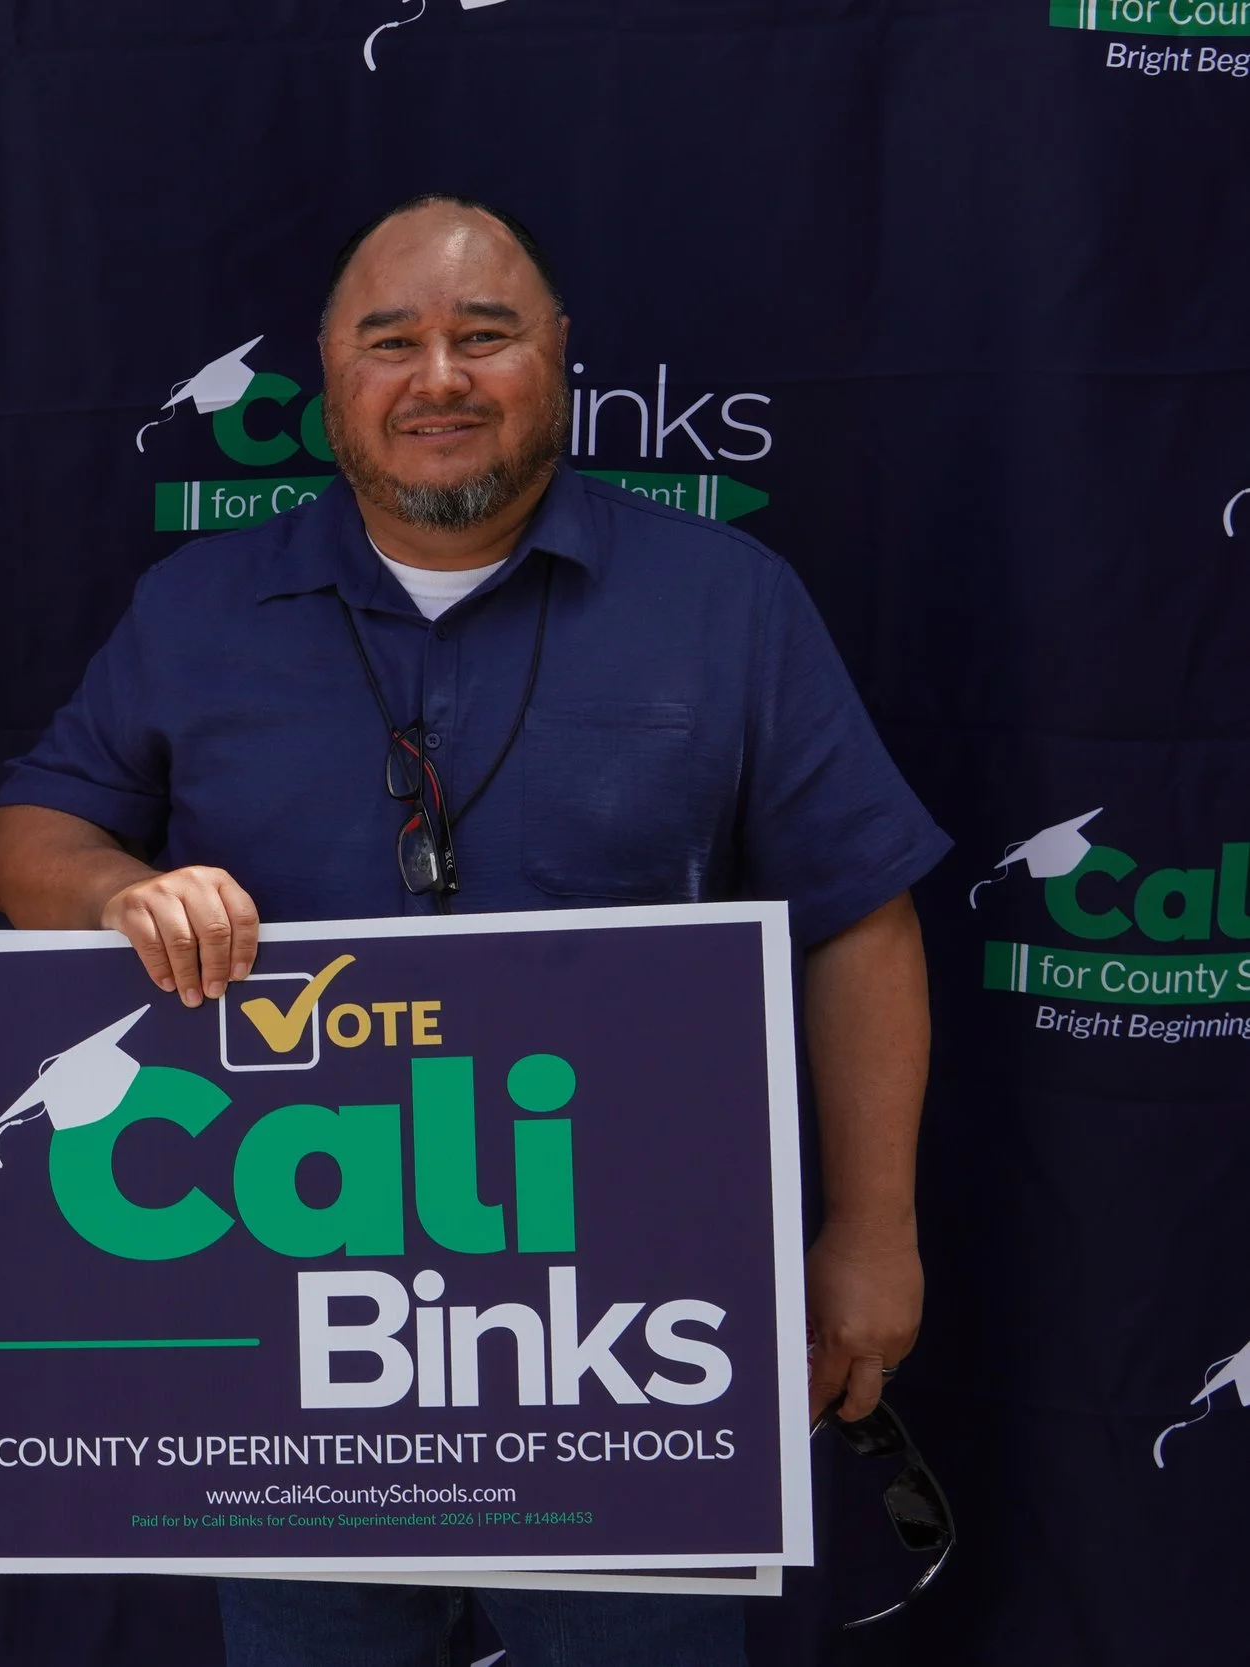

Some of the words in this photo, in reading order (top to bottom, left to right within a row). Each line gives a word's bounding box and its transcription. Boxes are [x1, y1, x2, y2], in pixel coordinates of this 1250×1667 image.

[1111, 0, 1160, 22] for
[1106, 42, 1192, 76] Bright
[571, 363, 773, 462] inks
[211, 488, 262, 519] for
[1039, 955, 1091, 989] for
[1100, 961, 1228, 998] County
[1035, 1005, 1122, 1039] Bright
[48, 1054, 576, 1261] Cali
[298, 1266, 733, 1409] Binks
[157, 1433, 487, 1466] SUPERINTENDENT
[495, 1432, 547, 1463] OF
[556, 1429, 735, 1462] SCHOOLS
[206, 1484, 516, 1508] www.Cali4CountySchools.com
[131, 1514, 158, 1527] Paid
[162, 1514, 179, 1527] for
[183, 1514, 198, 1530] by
[202, 1513, 225, 1527] Cali
[229, 1513, 263, 1527] Binks
[267, 1513, 285, 1527] for
[288, 1514, 334, 1529] County
[337, 1512, 436, 1529] Superintendent
[440, 1513, 473, 1526] 2026
[485, 1512, 521, 1525] FPPC
[524, 1512, 593, 1526] #1484453
